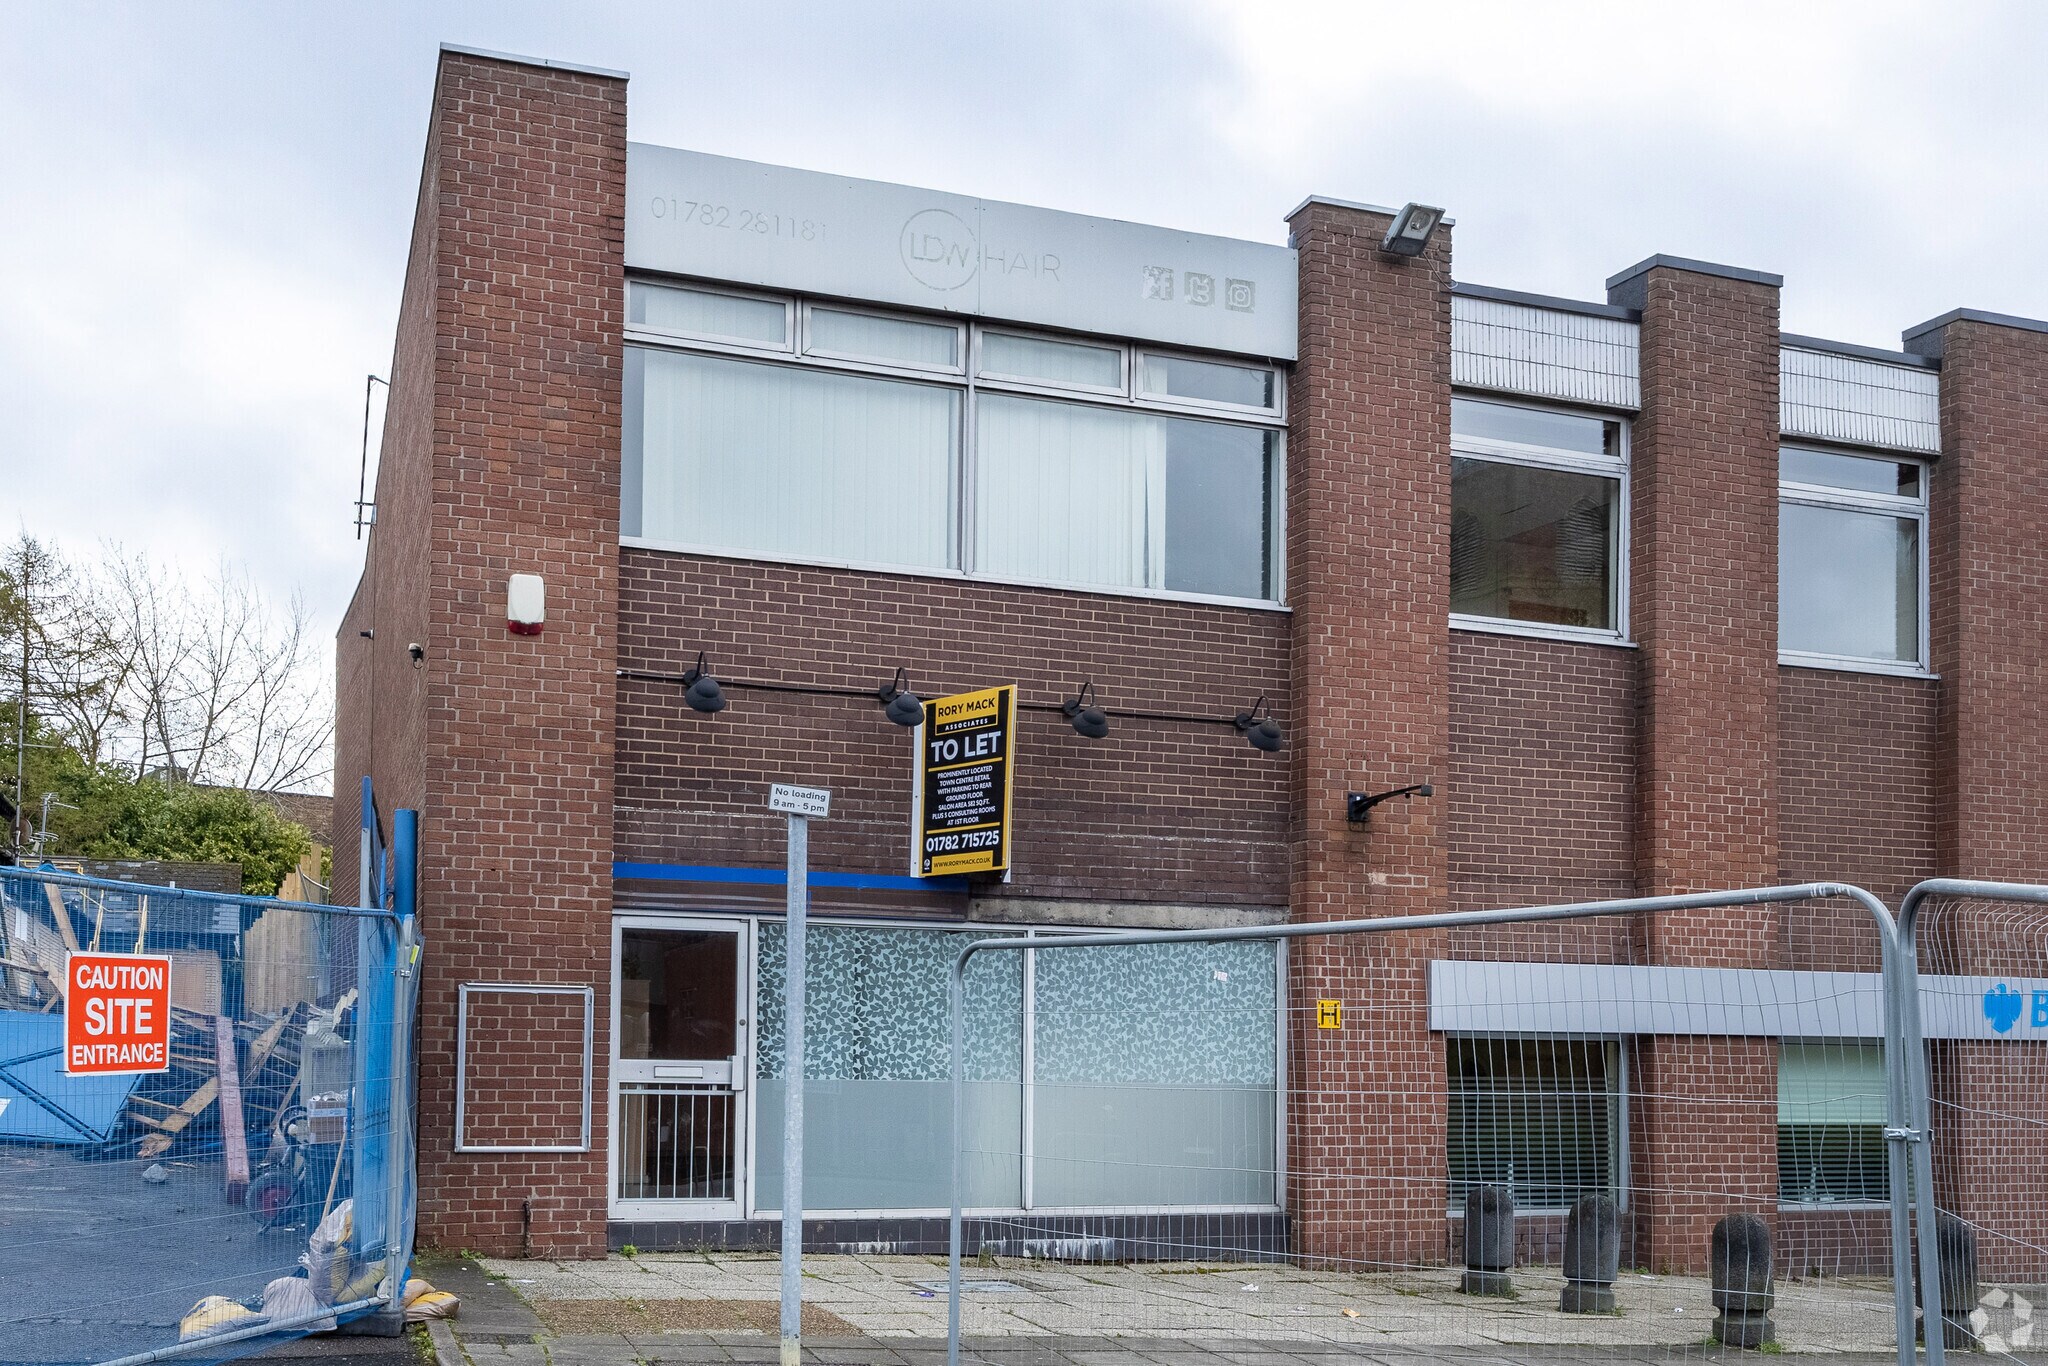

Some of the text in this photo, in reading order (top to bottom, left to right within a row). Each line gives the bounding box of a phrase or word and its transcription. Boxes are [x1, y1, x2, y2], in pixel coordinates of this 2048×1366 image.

[651, 196, 730, 229] 01782
[984, 244, 1061, 282] HAIR
[938, 697, 995, 717] RORY MACK
[945, 718, 988, 731] ASSOCIATES
[931, 730, 1002, 762] TO LET
[937, 765, 993, 779] PROMINENTLY LOCATED
[939, 774, 991, 787] TOWN CENTRE RETAIL
[775, 788, 826, 802] No loading
[951, 785, 972, 793] PARKING
[945, 791, 984, 802] GROUND FLOOR
[938, 803, 955, 811] SALON
[955, 801, 967, 809] AREA
[947, 808, 978, 818] CONSULTING
[978, 805, 996, 814] ROOMS
[963, 816, 979, 824] FLOOR
[926, 830, 1000, 852] 01782 715725
[933, 857, 991, 868] WWW.RORYMACK.CO.UK
[76, 964, 163, 990] CAUTION
[84, 997, 153, 1036] SITE
[1320, 1002, 1338, 1026] H
[72, 1042, 164, 1066] ENTRANCE
